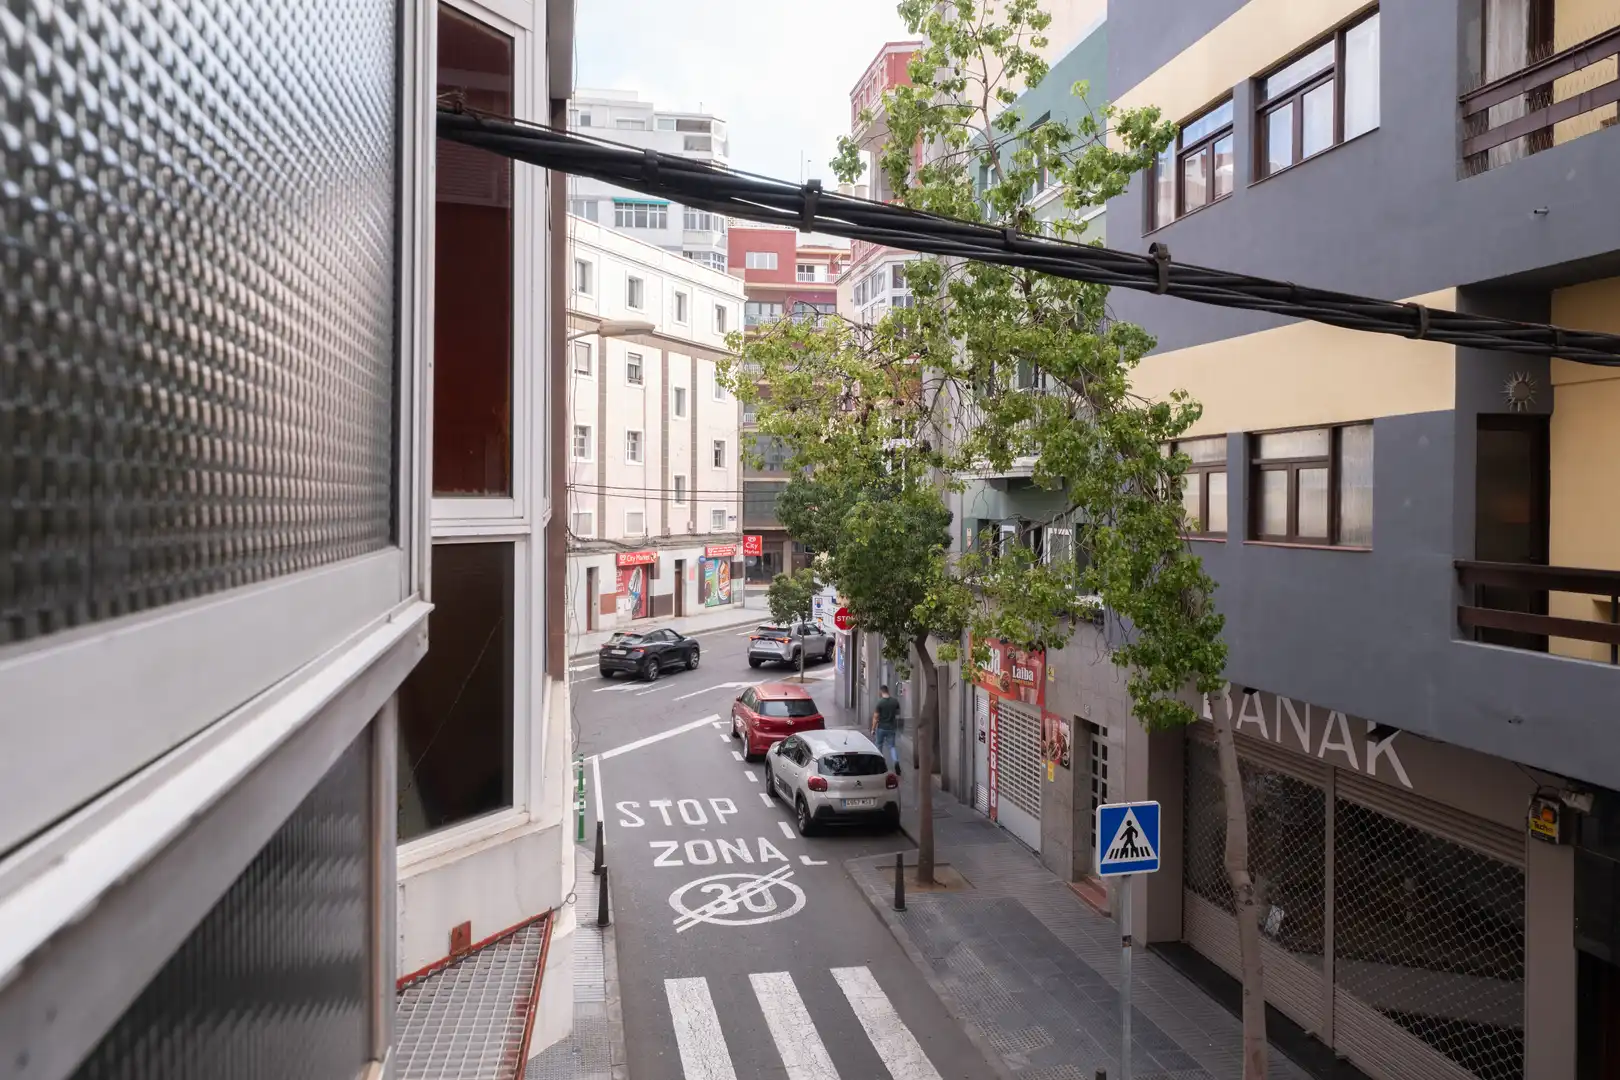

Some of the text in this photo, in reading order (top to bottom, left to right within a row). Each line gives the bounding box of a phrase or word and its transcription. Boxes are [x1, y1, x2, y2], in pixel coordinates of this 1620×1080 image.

[745, 542, 758, 550] City
[1012, 665, 1034, 682] Laiba
[615, 797, 739, 828] STOP
[649, 837, 790, 867] ZONA
